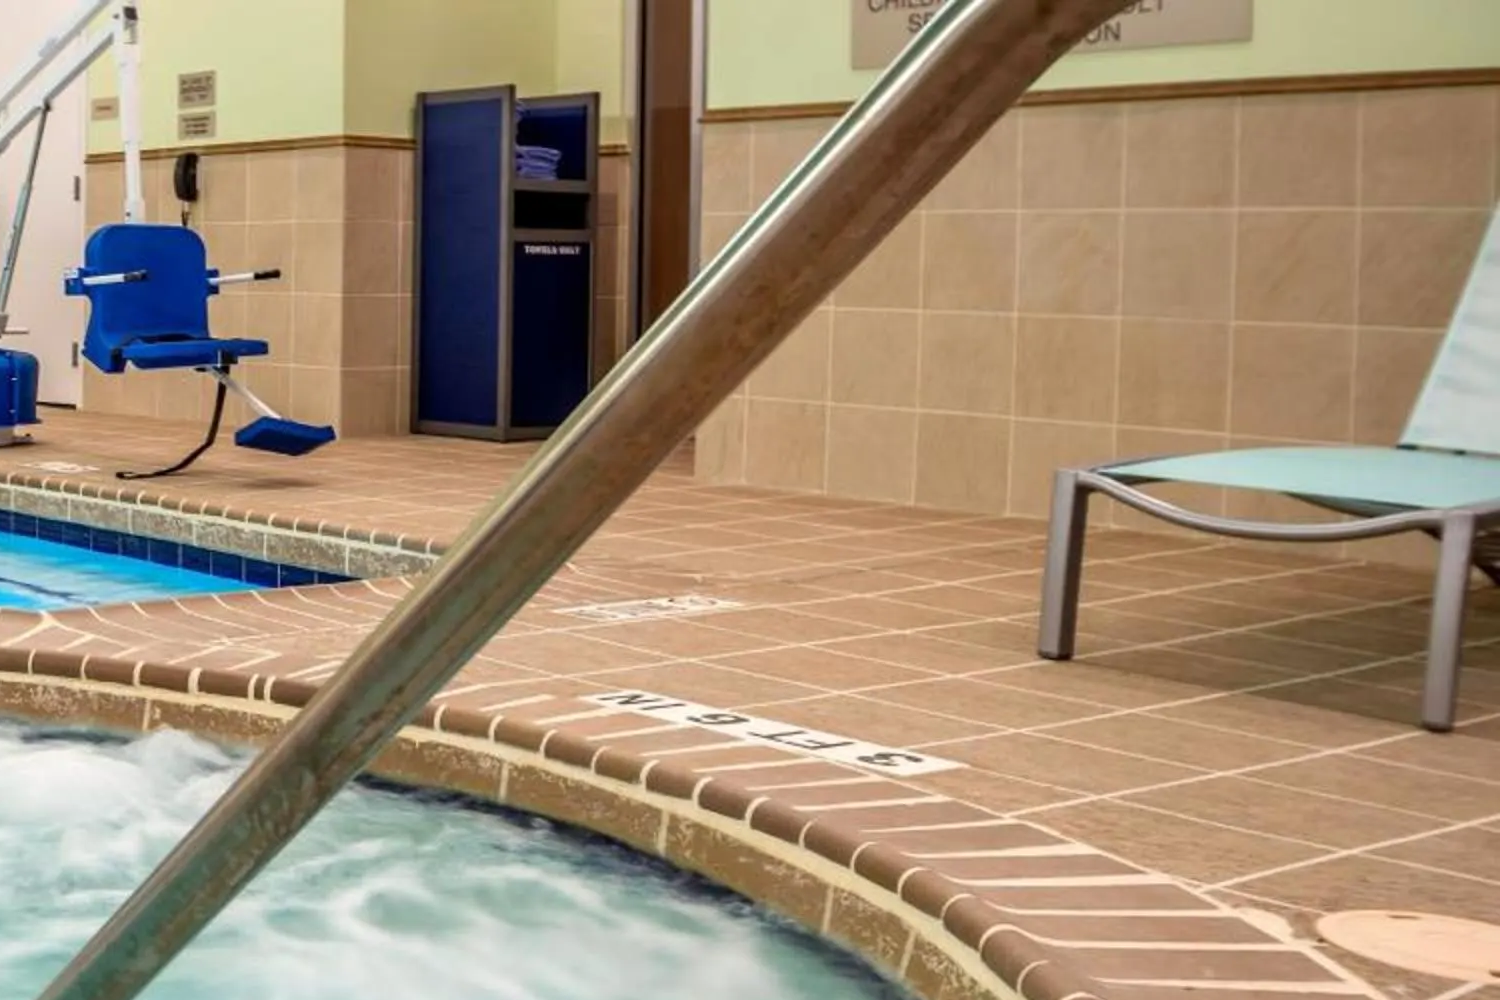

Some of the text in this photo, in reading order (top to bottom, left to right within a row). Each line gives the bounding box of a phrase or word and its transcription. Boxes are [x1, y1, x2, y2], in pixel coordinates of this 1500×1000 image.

[596, 694, 924, 767] 3 FT 6 IN
